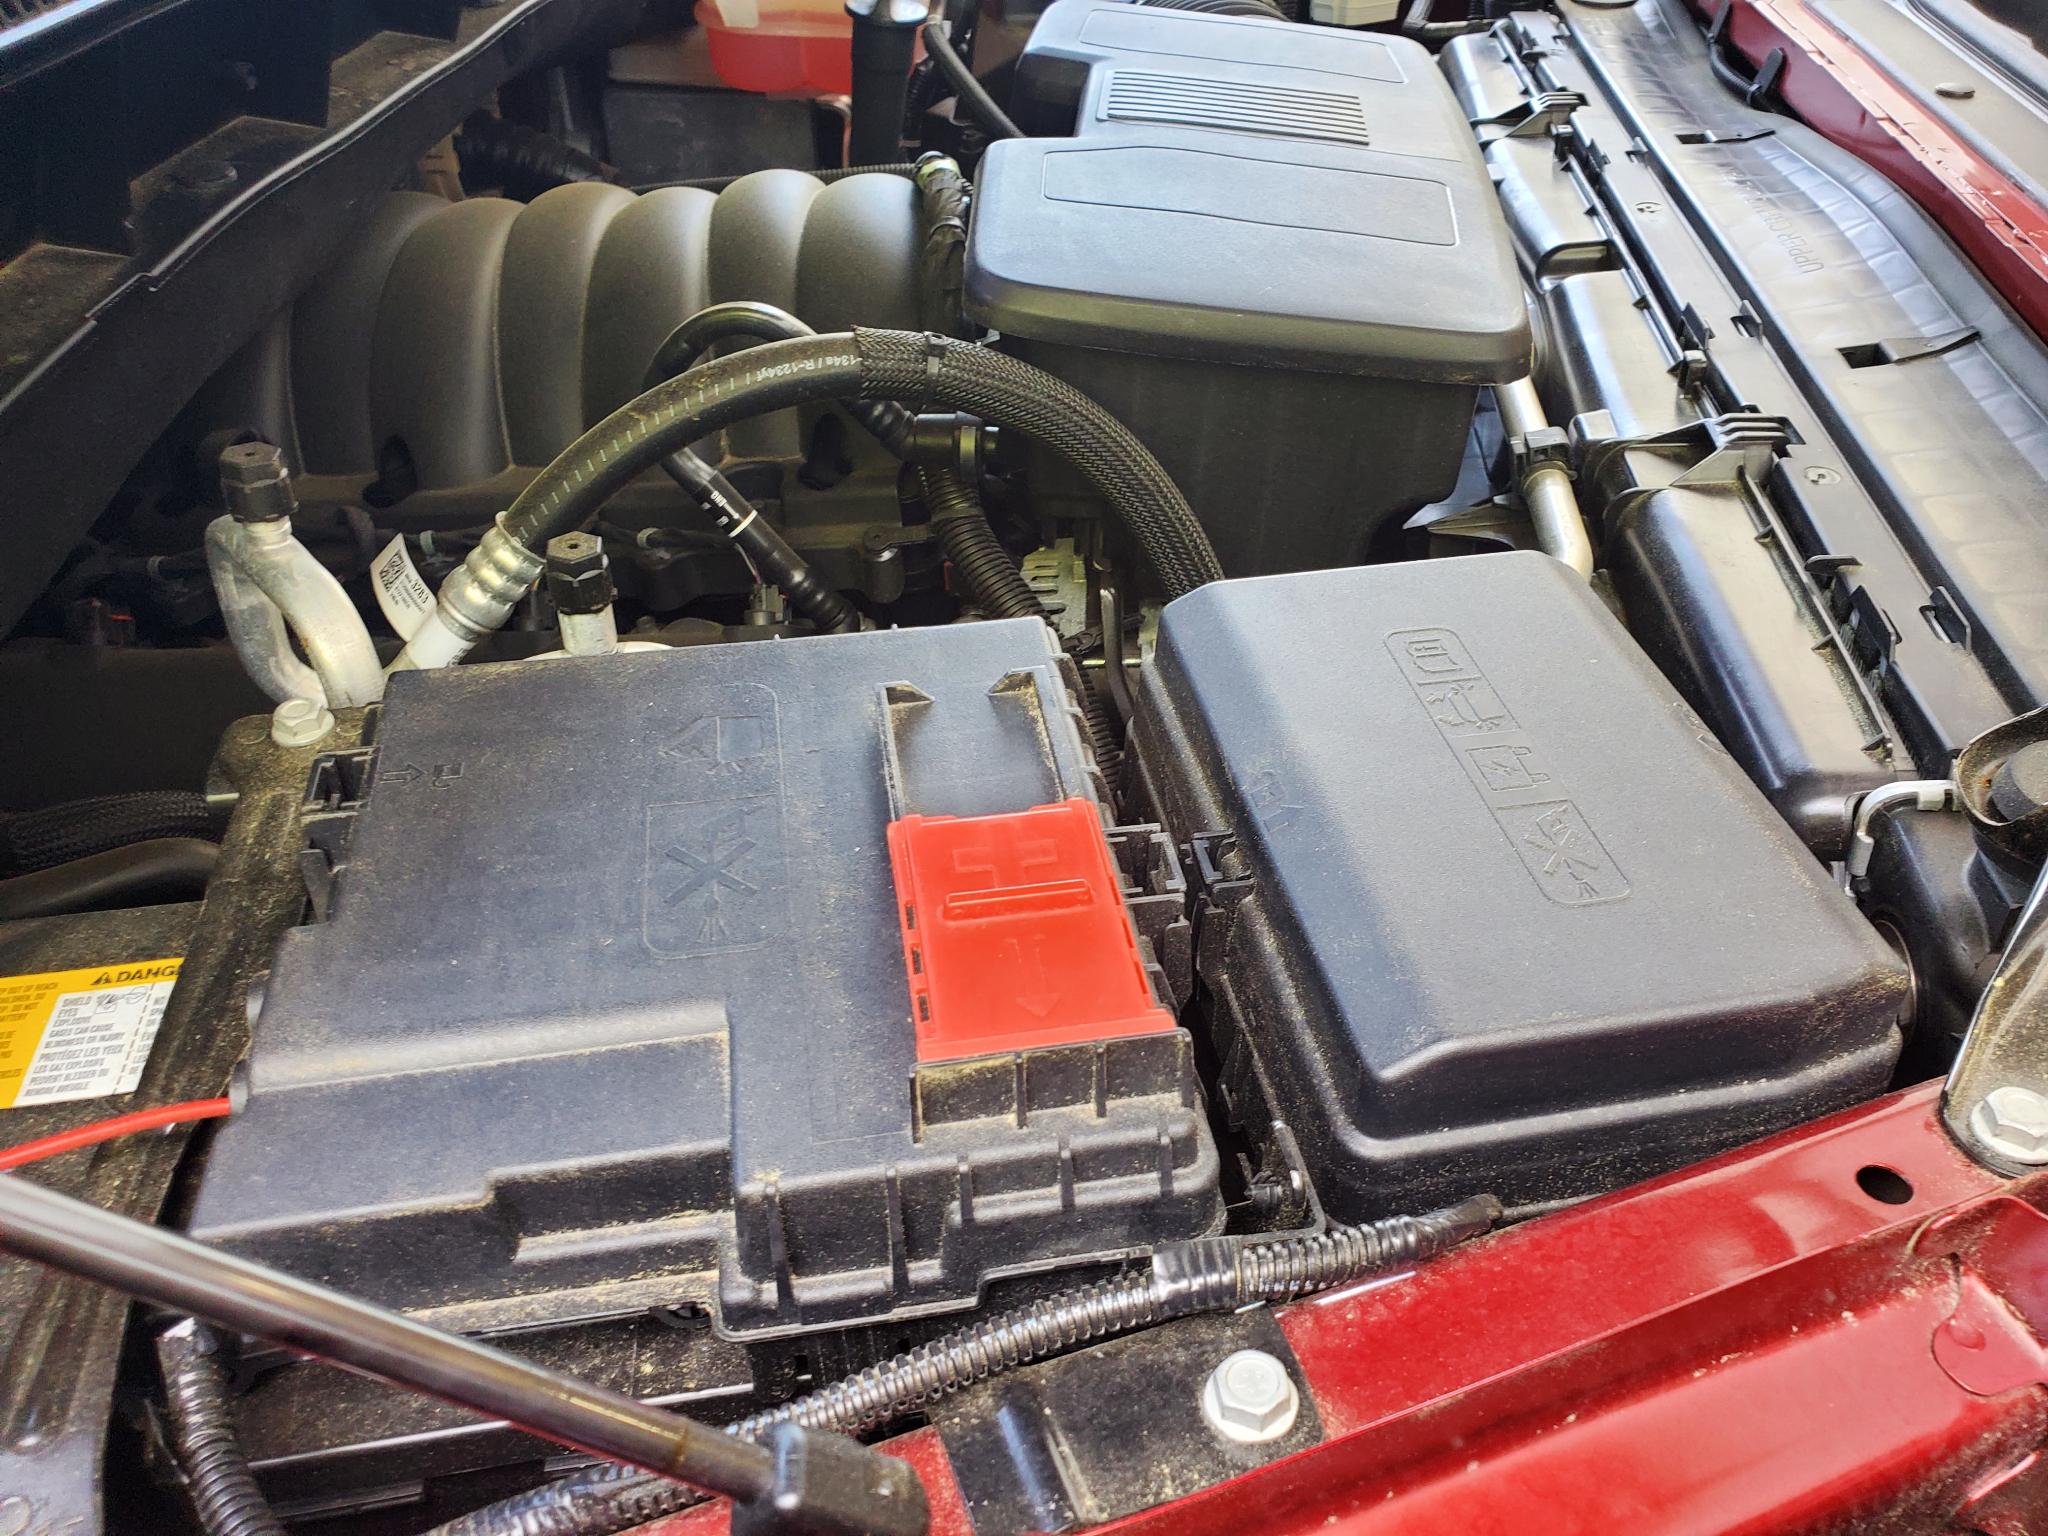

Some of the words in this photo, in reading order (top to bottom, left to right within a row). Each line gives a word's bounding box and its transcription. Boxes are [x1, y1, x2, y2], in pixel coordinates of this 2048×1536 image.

[1775, 232, 1824, 274] UPPER
[756, 359, 816, 382] R-1234yf
[116, 965, 179, 982] DANG
[58, 1008, 78, 1018] EYES
[74, 1027, 89, 1036] CAN
[84, 1047, 100, 1058] LES
[34, 1065, 48, 1074] LES
[49, 1063, 64, 1073] GAZ
